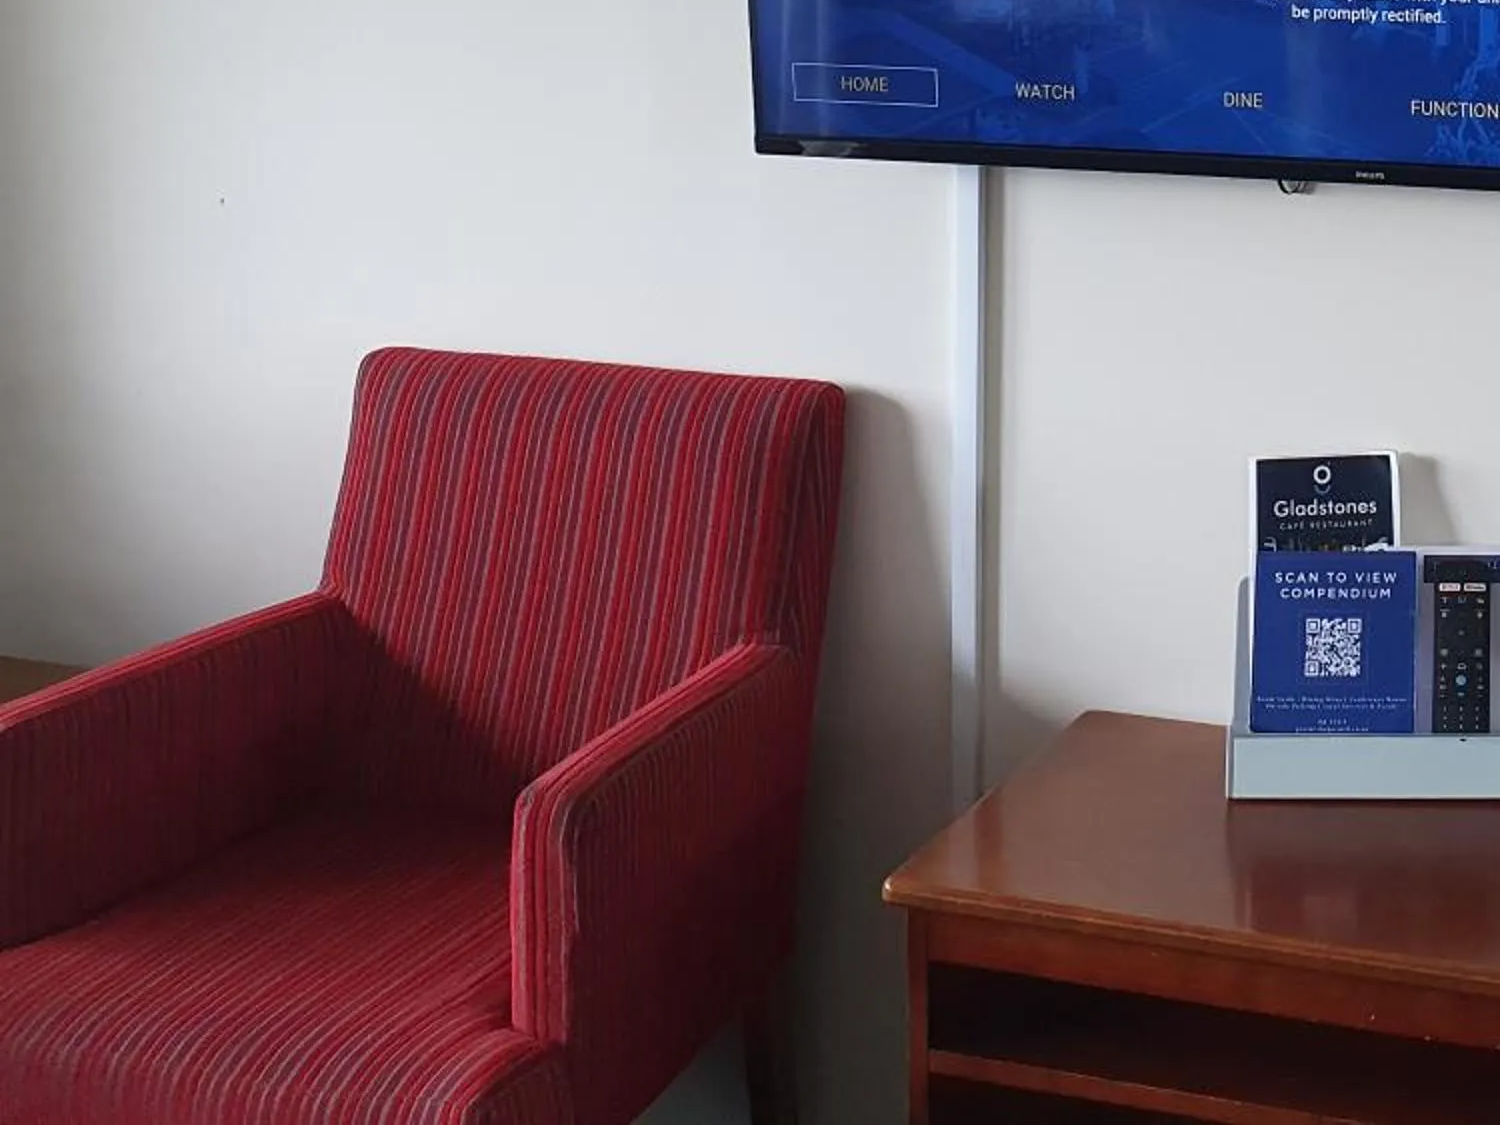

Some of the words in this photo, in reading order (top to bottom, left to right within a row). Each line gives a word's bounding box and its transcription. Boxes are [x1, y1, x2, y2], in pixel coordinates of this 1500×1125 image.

[1291, 5, 1310, 19] be
[1313, 8, 1378, 24] promptly
[841, 75, 889, 92] HOME
[1015, 82, 1076, 101] WATCH
[1223, 91, 1264, 109] DINE
[1273, 498, 1378, 518] Gladstones
[1274, 572, 1319, 584] SCAN
[1326, 572, 1347, 584] TO
[1355, 572, 1397, 584] VIEW
[1279, 588, 1392, 600] COMPENDIUM
